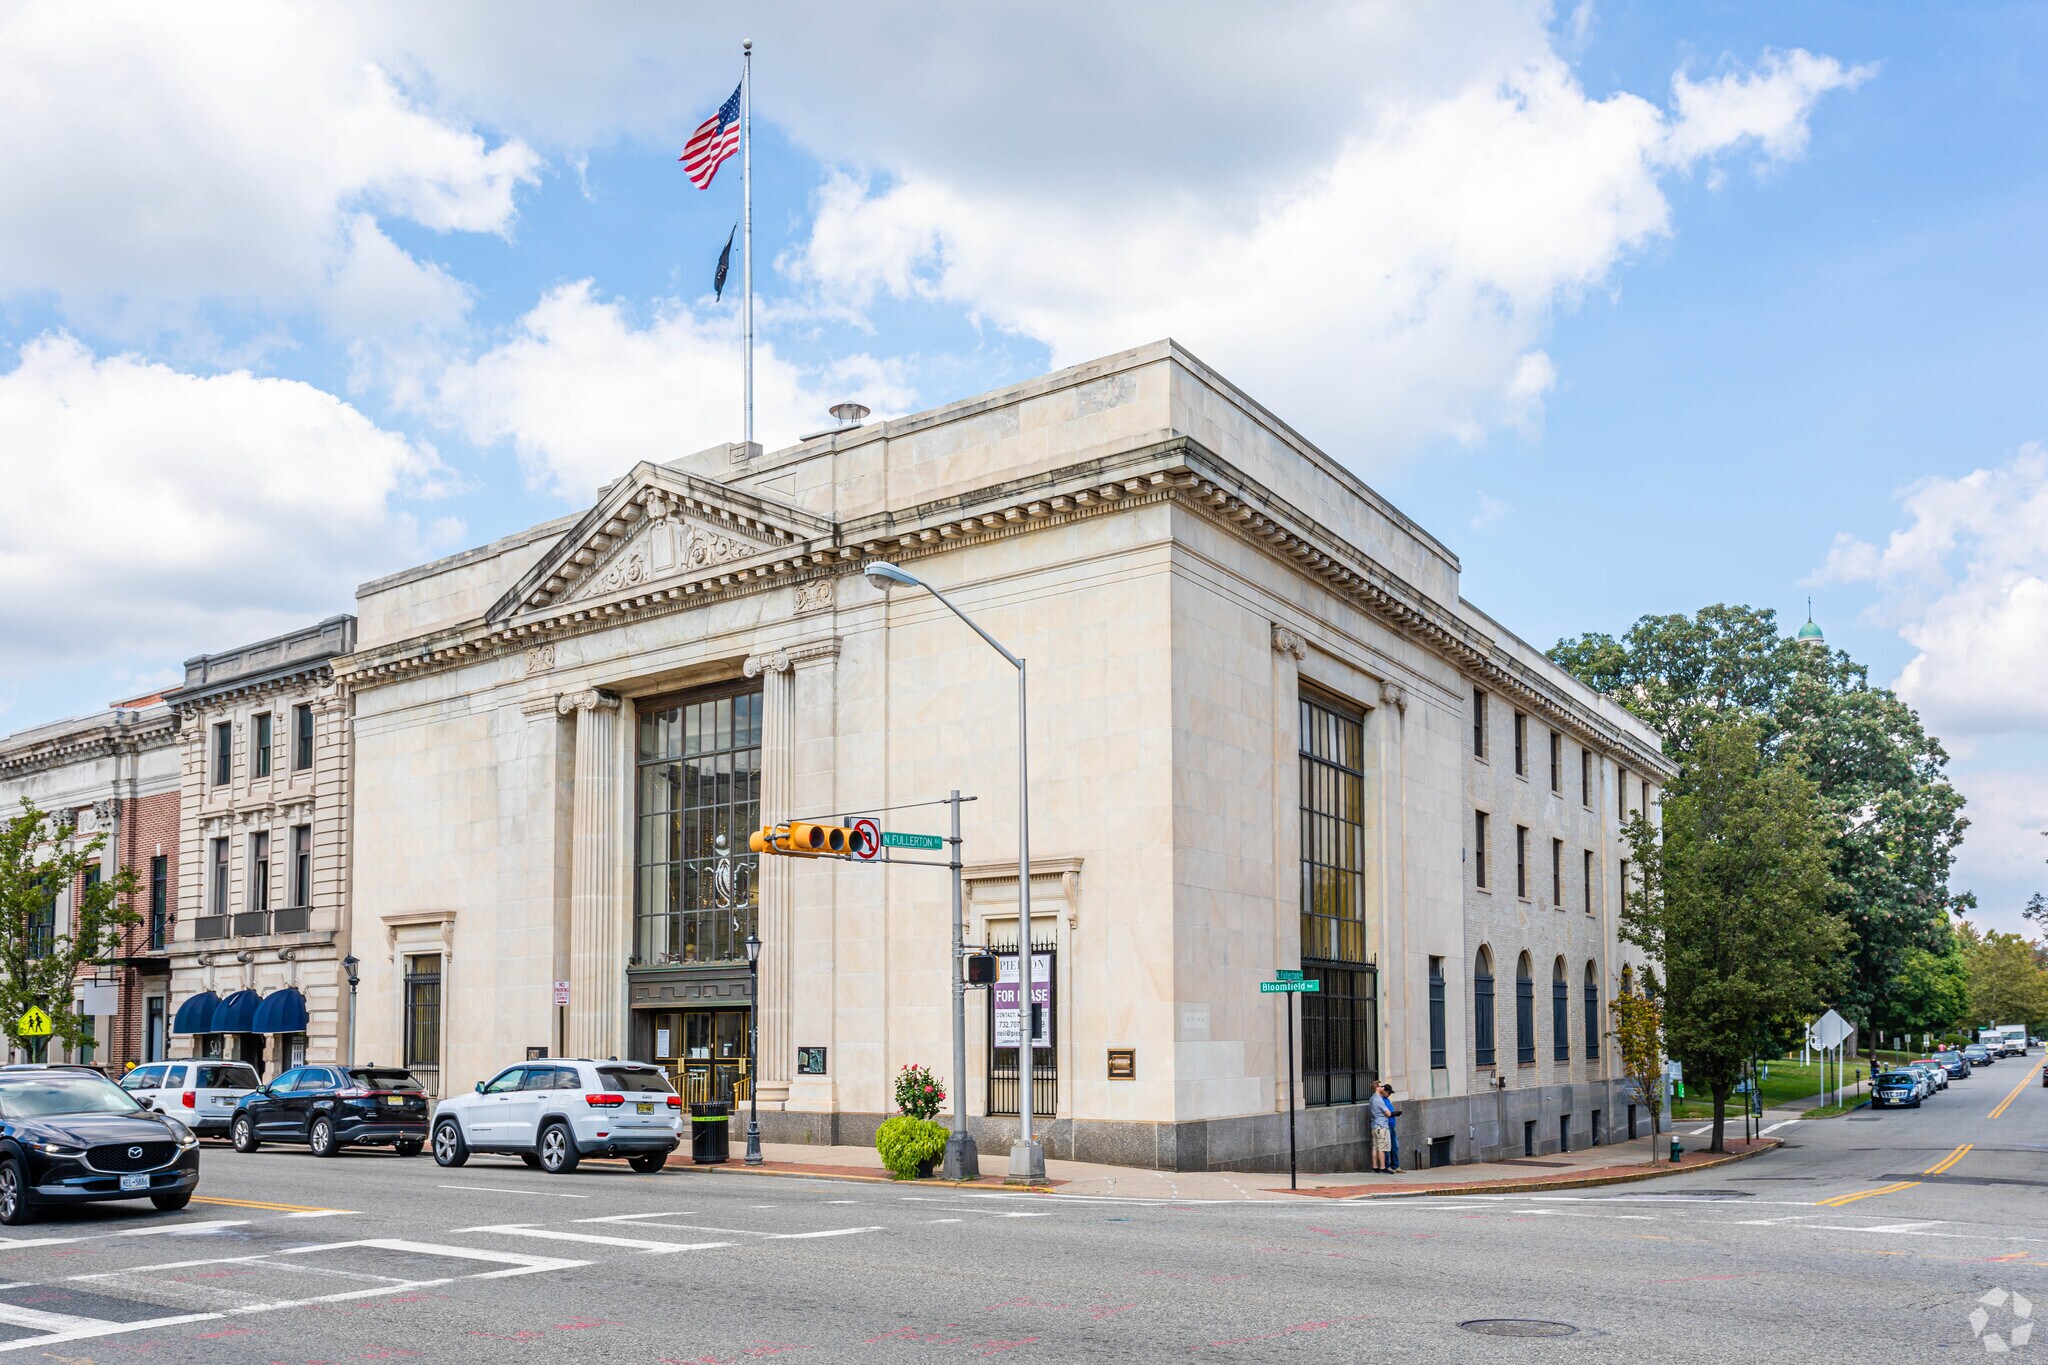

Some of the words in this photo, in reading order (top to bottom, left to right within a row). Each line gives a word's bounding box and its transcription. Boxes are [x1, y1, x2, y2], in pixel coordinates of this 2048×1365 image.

[884, 834, 890, 844] N
[892, 834, 932, 847] FULLERTON
[1000, 960, 1044, 970] PIEON
[1262, 983, 1305, 991] Bloomfield
[996, 990, 1014, 1002] FOR
[1018, 989, 1047, 1001] ASE
